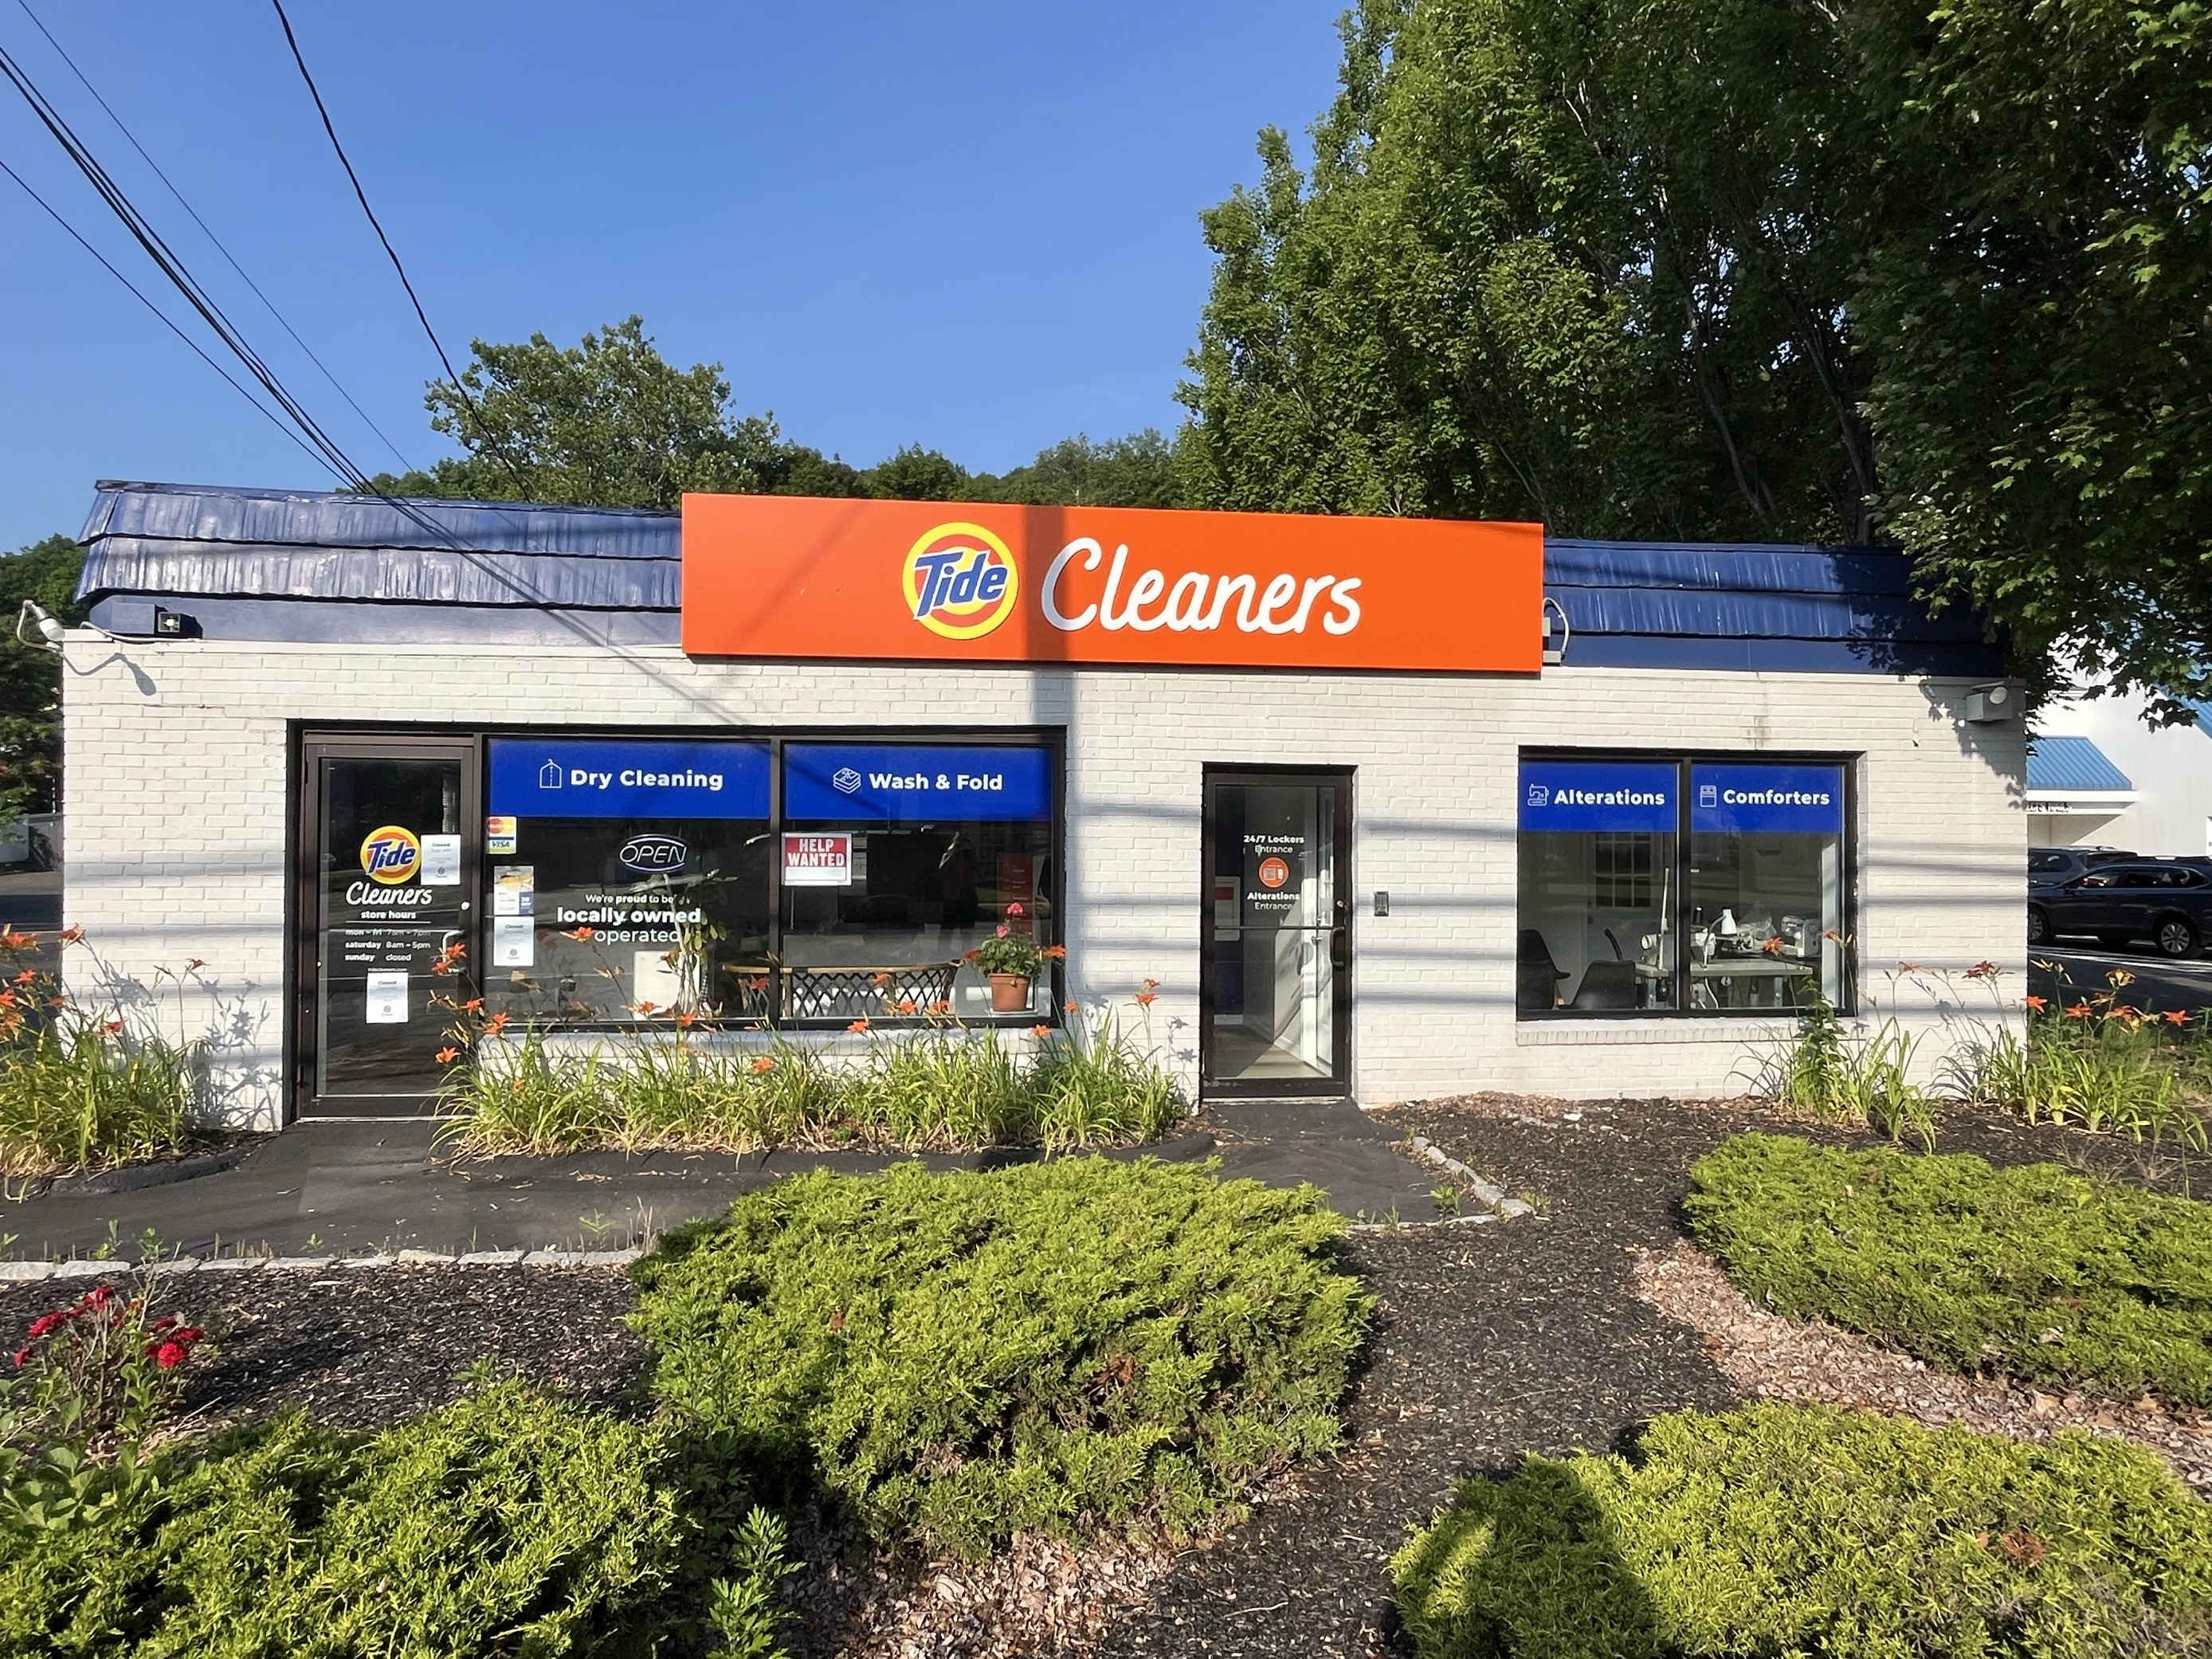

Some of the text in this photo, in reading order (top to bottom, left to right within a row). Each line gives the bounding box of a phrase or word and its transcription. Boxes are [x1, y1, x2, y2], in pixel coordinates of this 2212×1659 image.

[912, 537, 1362, 635] Tide Cleaners
[571, 769, 724, 791] Dry Cleaning
[869, 773, 1002, 790] Wash & Fold
[1554, 789, 1665, 806] Alterations
[1724, 789, 1830, 806] Comforters
[619, 845, 687, 863] OPEN
[799, 838, 834, 853] HELP
[1254, 845, 1293, 853] Entrance
[366, 840, 416, 876] Tide
[787, 853, 845, 867] WANTED
[346, 881, 432, 905] Cleaners
[586, 894, 674, 904] We're proud to be
[1247, 892, 1300, 900] Alterations
[388, 910, 417, 919] hours
[557, 907, 701, 926] locally owned
[412, 941, 431, 950] 5pm
[345, 953, 375, 962] sunday
